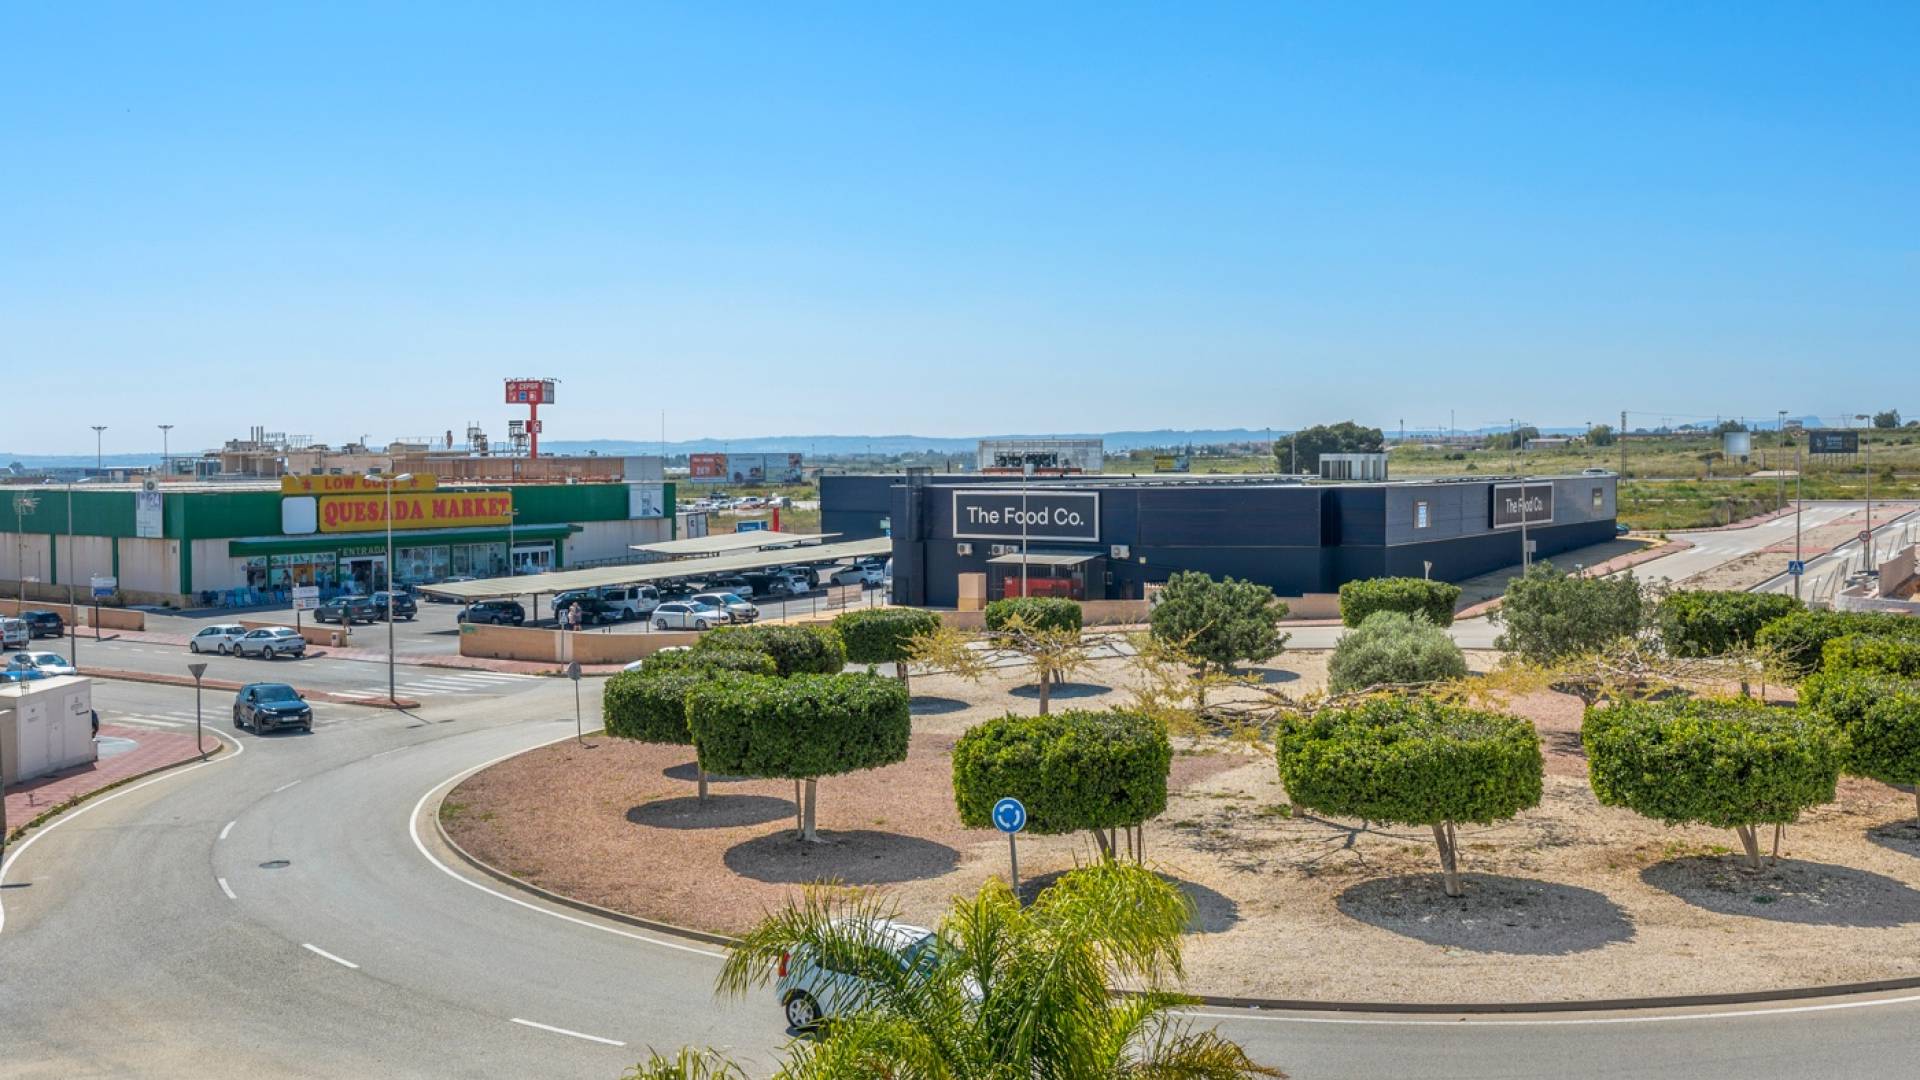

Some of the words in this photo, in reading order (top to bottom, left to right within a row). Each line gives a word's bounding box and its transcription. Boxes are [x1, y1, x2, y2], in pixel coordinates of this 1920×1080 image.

[324, 477, 355, 490] LOW
[324, 500, 425, 527] QUESADA
[431, 497, 510, 519] MARKET
[1505, 498, 1517, 513] The
[1518, 496, 1534, 513] Fod
[966, 506, 1000, 524] The
[1004, 506, 1049, 525] Food
[1054, 507, 1085, 526] Co.
[342, 545, 386, 556] ENTRADA
